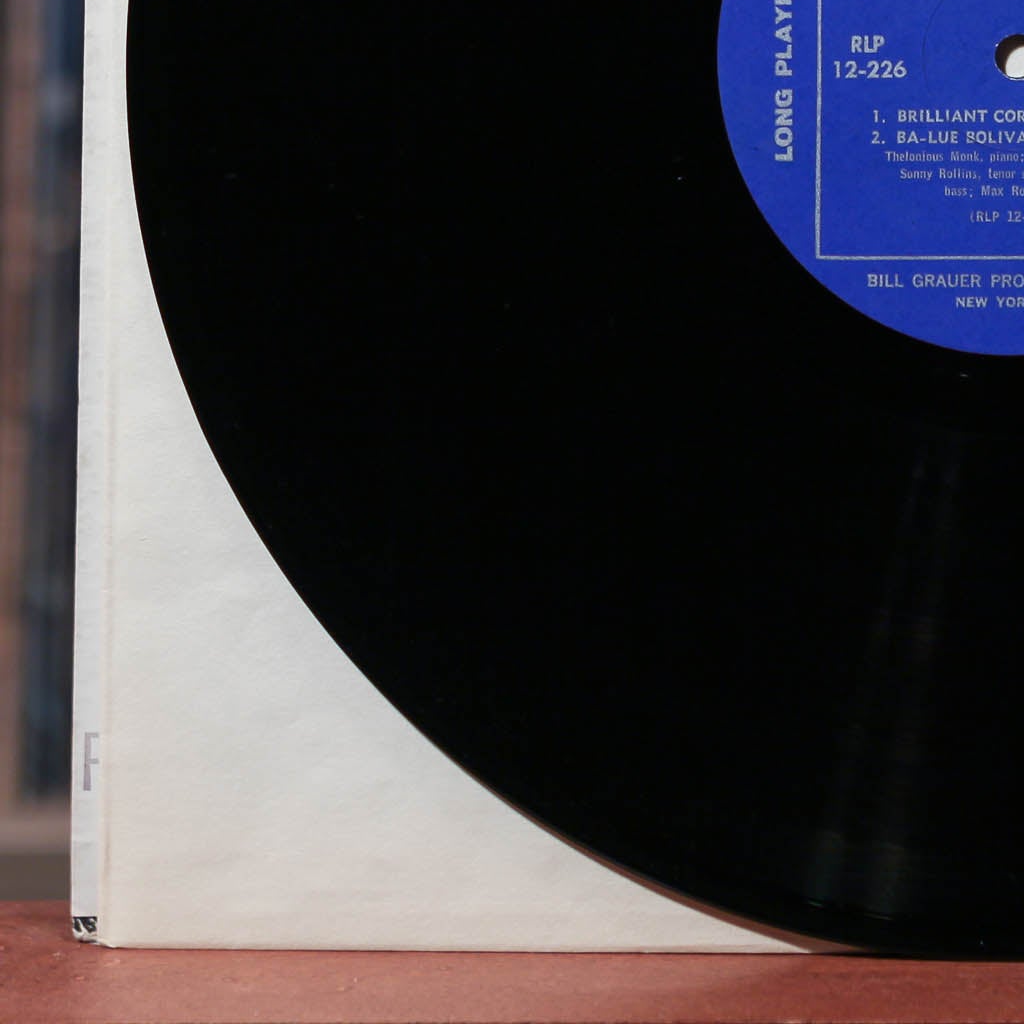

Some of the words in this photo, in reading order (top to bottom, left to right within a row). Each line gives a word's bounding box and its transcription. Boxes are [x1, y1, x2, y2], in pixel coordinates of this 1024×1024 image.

[851, 35, 885, 54] RLP
[833, 60, 907, 79] 12-226
[872, 109, 886, 124] 1.
[897, 109, 988, 123] BRILLIANT
[773, 88, 793, 162] LONG
[871, 131, 886, 145] 2.
[896, 130, 959, 144] BA-LUE
[884, 151, 944, 162] Thelonious
[900, 168, 933, 182] Sunny
[988, 168, 1015, 180] tenor
[981, 185, 1004, 197] Max
[970, 210, 1000, 225] (RLP
[867, 273, 903, 288] BILL
[912, 273, 981, 288] GRAUER
[955, 296, 988, 308] NEW
